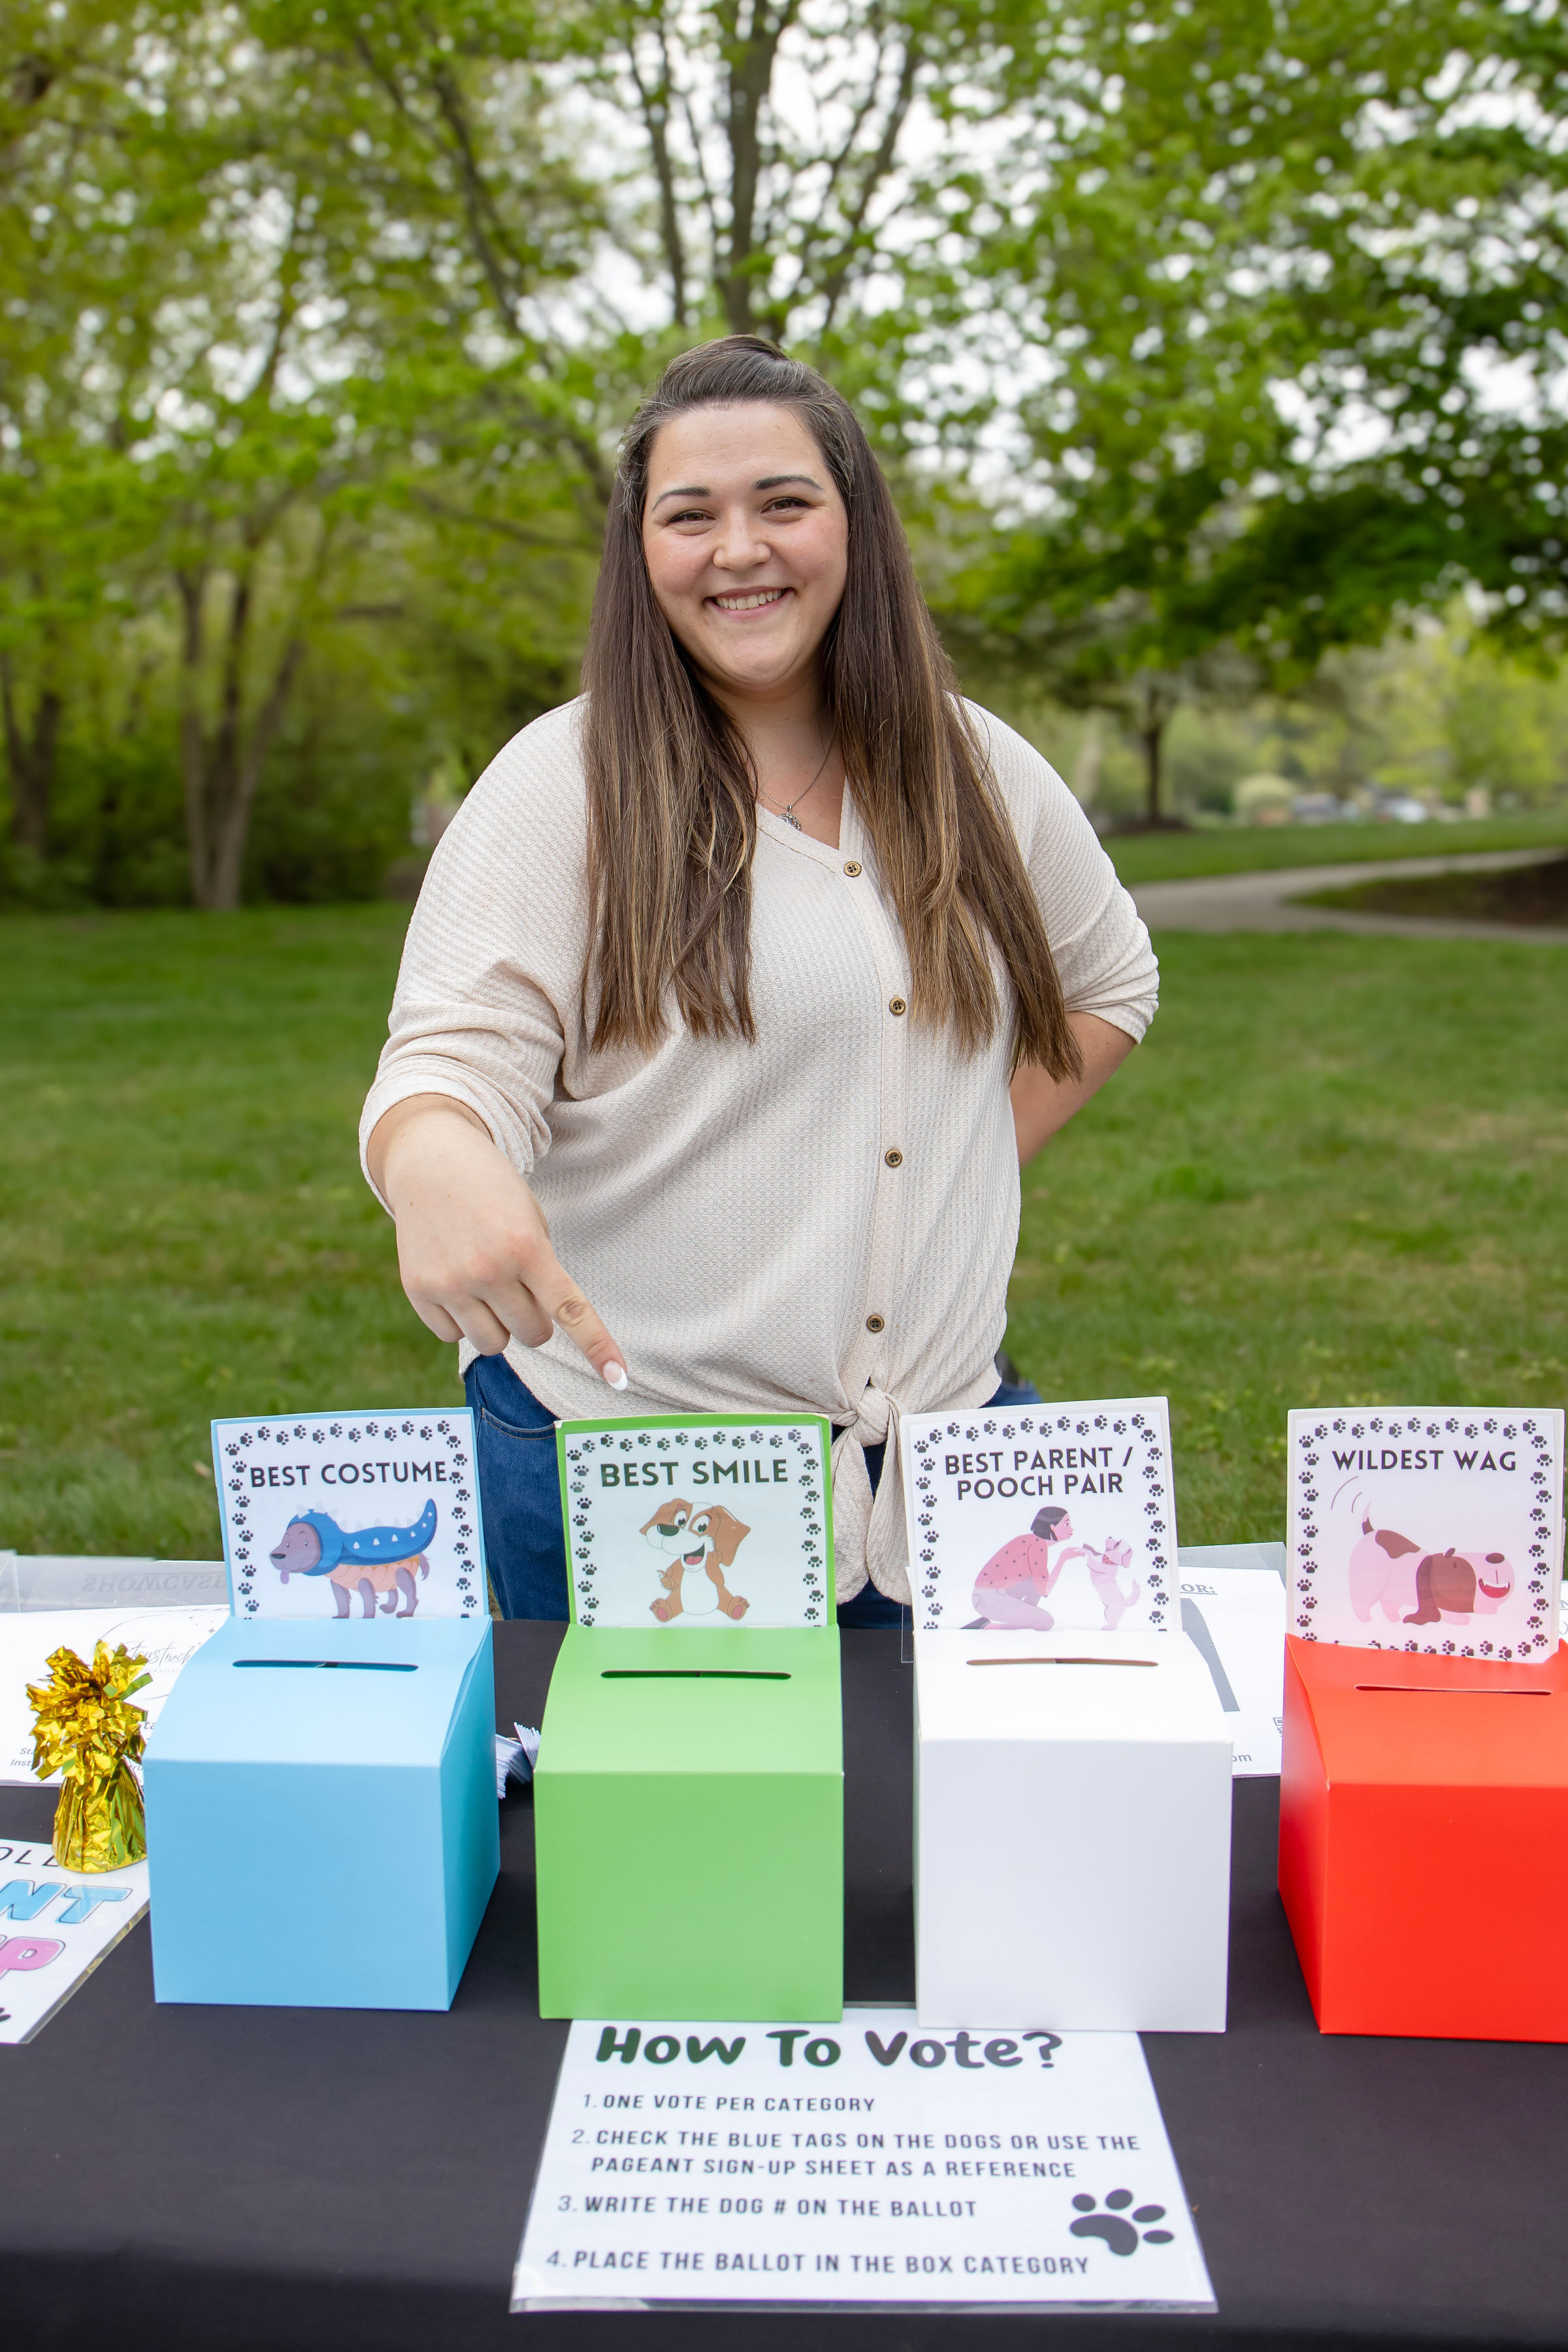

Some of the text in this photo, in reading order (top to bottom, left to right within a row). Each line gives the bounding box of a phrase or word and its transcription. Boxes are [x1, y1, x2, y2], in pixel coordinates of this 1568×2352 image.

[945, 1446, 1134, 1475] BEST PARENT /
[1331, 1449, 1516, 1471] WILDEST WAG
[250, 1461, 448, 1488] BEST COSTUME
[600, 1458, 789, 1488] BEST SMILE
[957, 1473, 1124, 1501] POOCH PAIR
[595, 2025, 1063, 2069] How To Vote?
[603, 2094, 644, 2109] ONE
[654, 2095, 706, 2110] VOTE
[716, 2097, 755, 2111] PER
[764, 2097, 875, 2112] CATEGORY
[571, 2129, 1140, 2150] 2. CHECK THE BLUE TAGS ON THE DOGS OR USE THE
[591, 2157, 1076, 2178] PAGEANT SIGN-UP SHEET AS A REFERENCE
[557, 2195, 976, 2217] 3. WRITE THE DOG # ON THE BALLOT
[546, 2249, 1088, 2274] 4. PLACE THE BALLOT IN THE BOX CATEGORY
